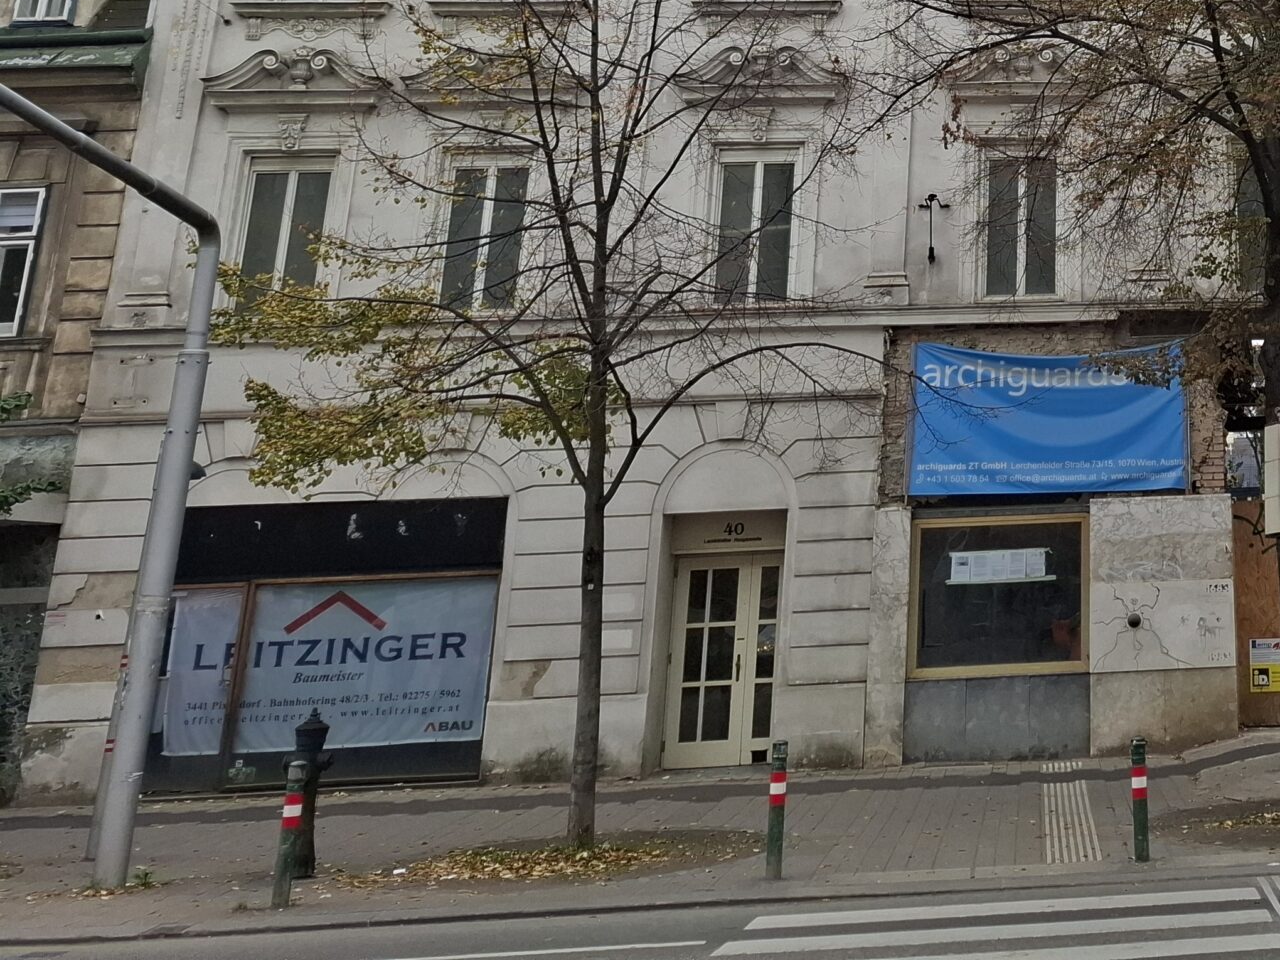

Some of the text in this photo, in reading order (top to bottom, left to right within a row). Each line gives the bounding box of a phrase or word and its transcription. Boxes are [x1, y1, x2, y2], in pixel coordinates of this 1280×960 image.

[916, 462, 966, 472] archiguards
[968, 461, 979, 470] ZT
[981, 461, 1007, 470] GmbH
[1110, 470, 1184, 481] www.archiguards.
[724, 522, 745, 536] 40
[292, 670, 364, 684] Baumeister
[185, 702, 208, 712] 3441
[211, 699, 263, 711] Pixdorf
[269, 695, 337, 708] Bahnhofsring
[338, 694, 369, 704] 48/2/3
[402, 691, 430, 701] 02275
[439, 689, 462, 699] 5962
[184, 703, 460, 727] officeeitzinger. www.leitzinger.at
